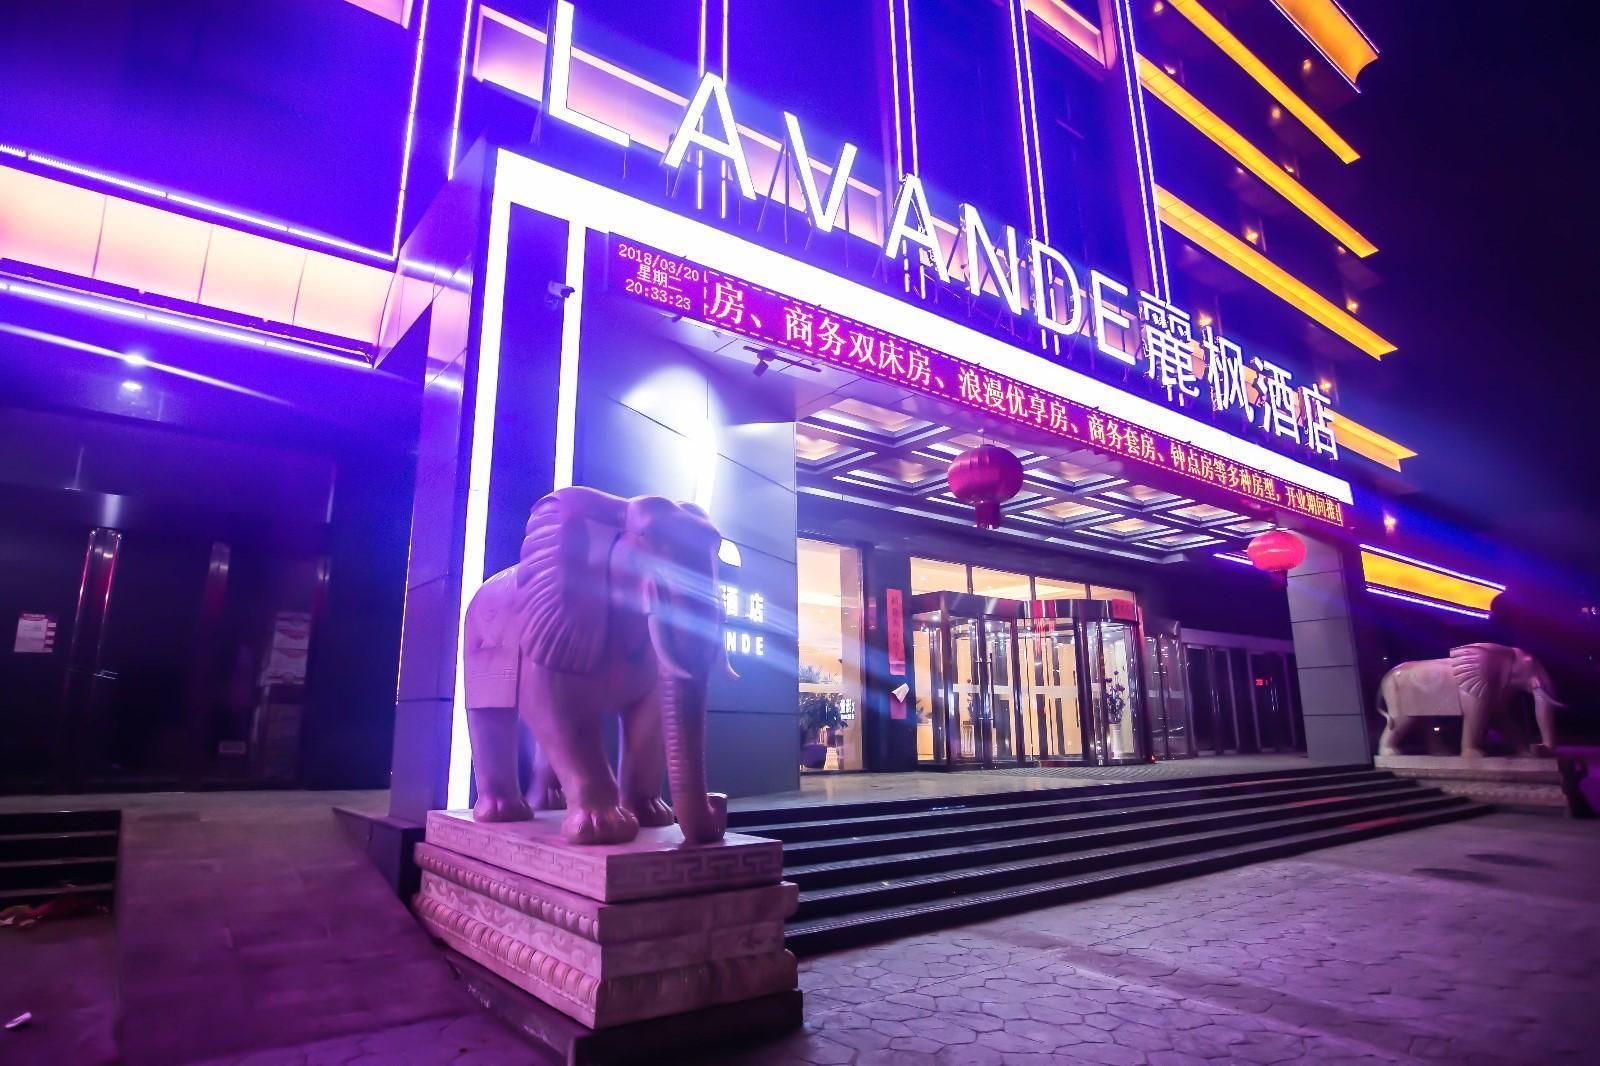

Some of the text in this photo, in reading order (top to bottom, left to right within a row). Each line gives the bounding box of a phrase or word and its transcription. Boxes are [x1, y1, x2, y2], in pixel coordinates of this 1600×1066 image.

[549, 0, 1137, 365] LAVANDE
[618, 243, 699, 281] 2018/03/20
[637, 264, 683, 292] 星期二
[625, 278, 691, 310] 20:33:23
